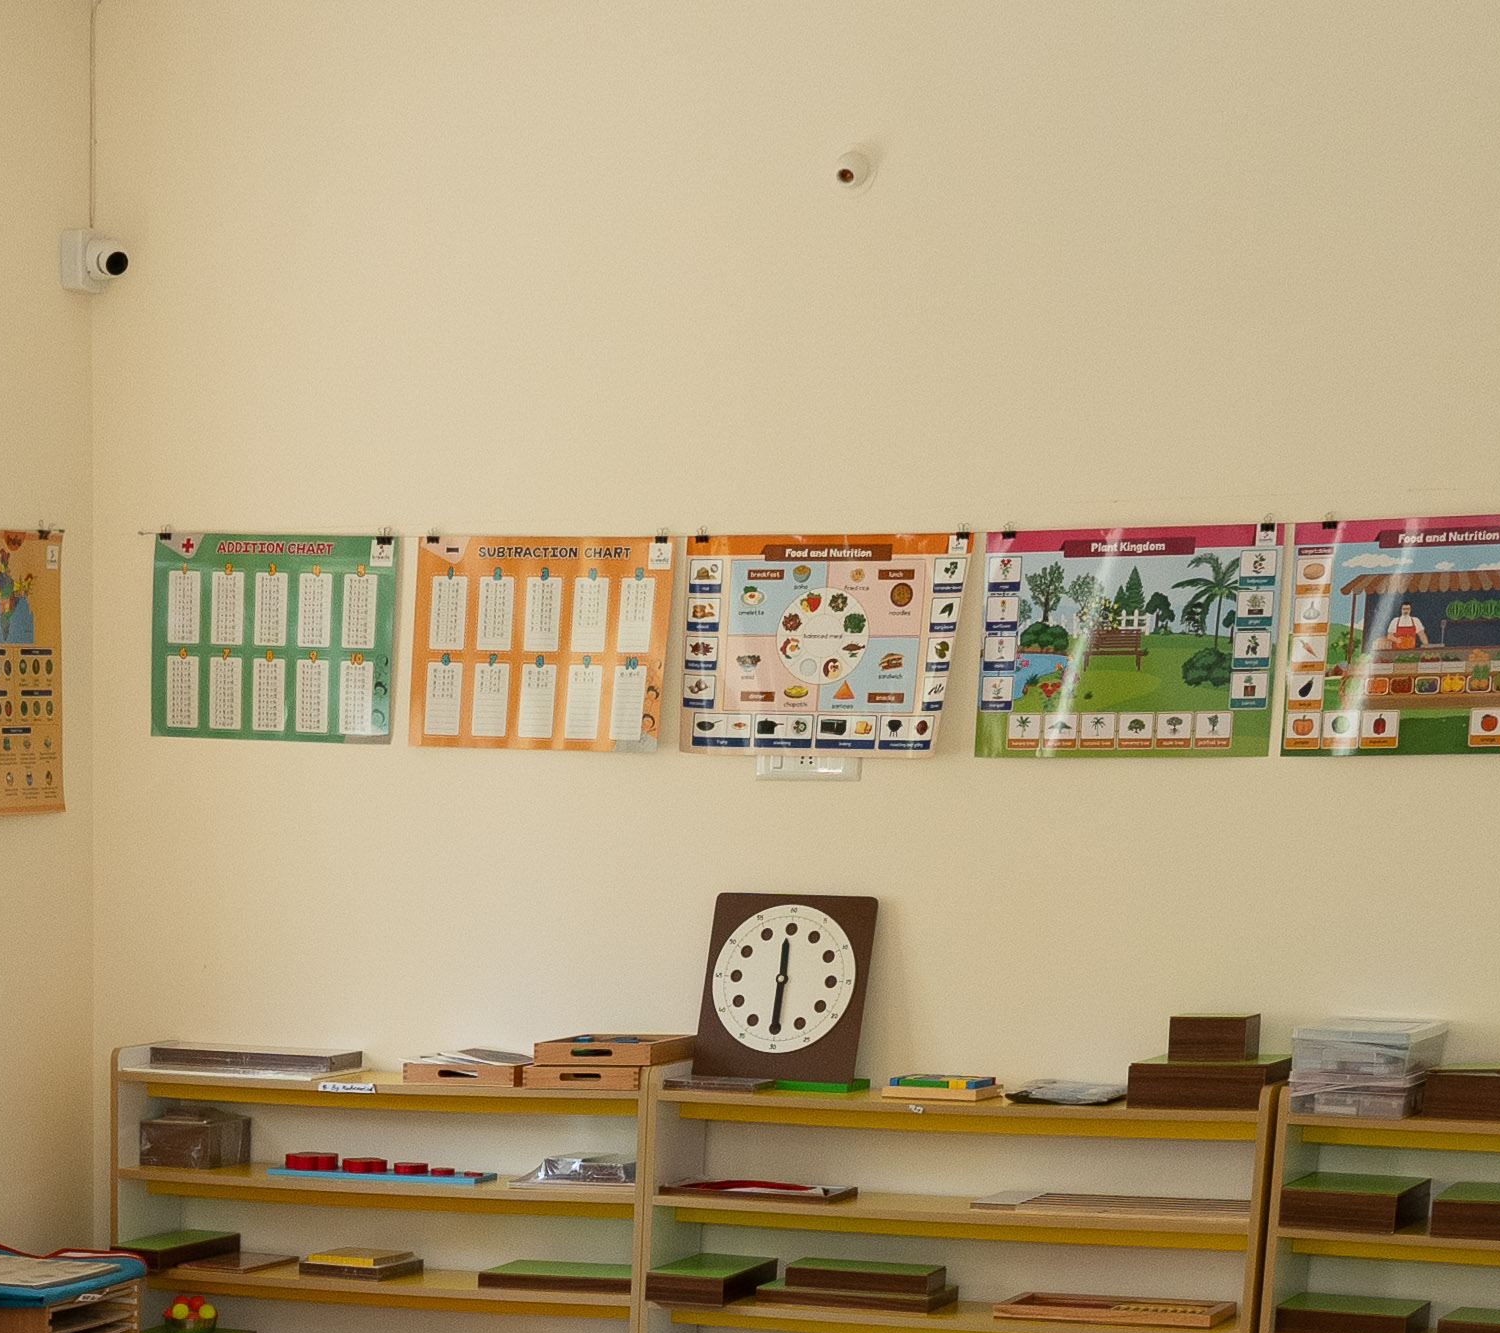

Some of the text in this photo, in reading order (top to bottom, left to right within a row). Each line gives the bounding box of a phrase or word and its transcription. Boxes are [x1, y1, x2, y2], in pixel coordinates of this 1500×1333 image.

[7, 536, 22, 546] India
[1398, 530, 1500, 544] Food and Nutrition
[217, 541, 334, 556] ADDITION CHART
[478, 546, 631, 559] SUBTRACTION CHART
[785, 548, 872, 558] Food and Nutrition
[1091, 541, 1165, 553] Plant Kingdom
[181, 562, 187, 574] 1
[225, 563, 233, 575] 2
[268, 563, 277, 576] 3
[312, 564, 321, 577] 4
[357, 564, 366, 577] 5
[447, 566, 453, 580] 1
[493, 566, 502, 580] 2
[541, 567, 550, 581] 3
[588, 568, 597, 581] 4
[635, 568, 644, 581] 5
[179, 648, 187, 659] 6
[222, 648, 231, 660] 7
[265, 649, 274, 662] 8
[309, 650, 317, 663] 9
[351, 652, 364, 665] 10
[441, 653, 450, 665] 6
[489, 654, 497, 666] 7
[536, 655, 544, 668] 8
[583, 655, 591, 668] 9
[625, 656, 638, 670] 10
